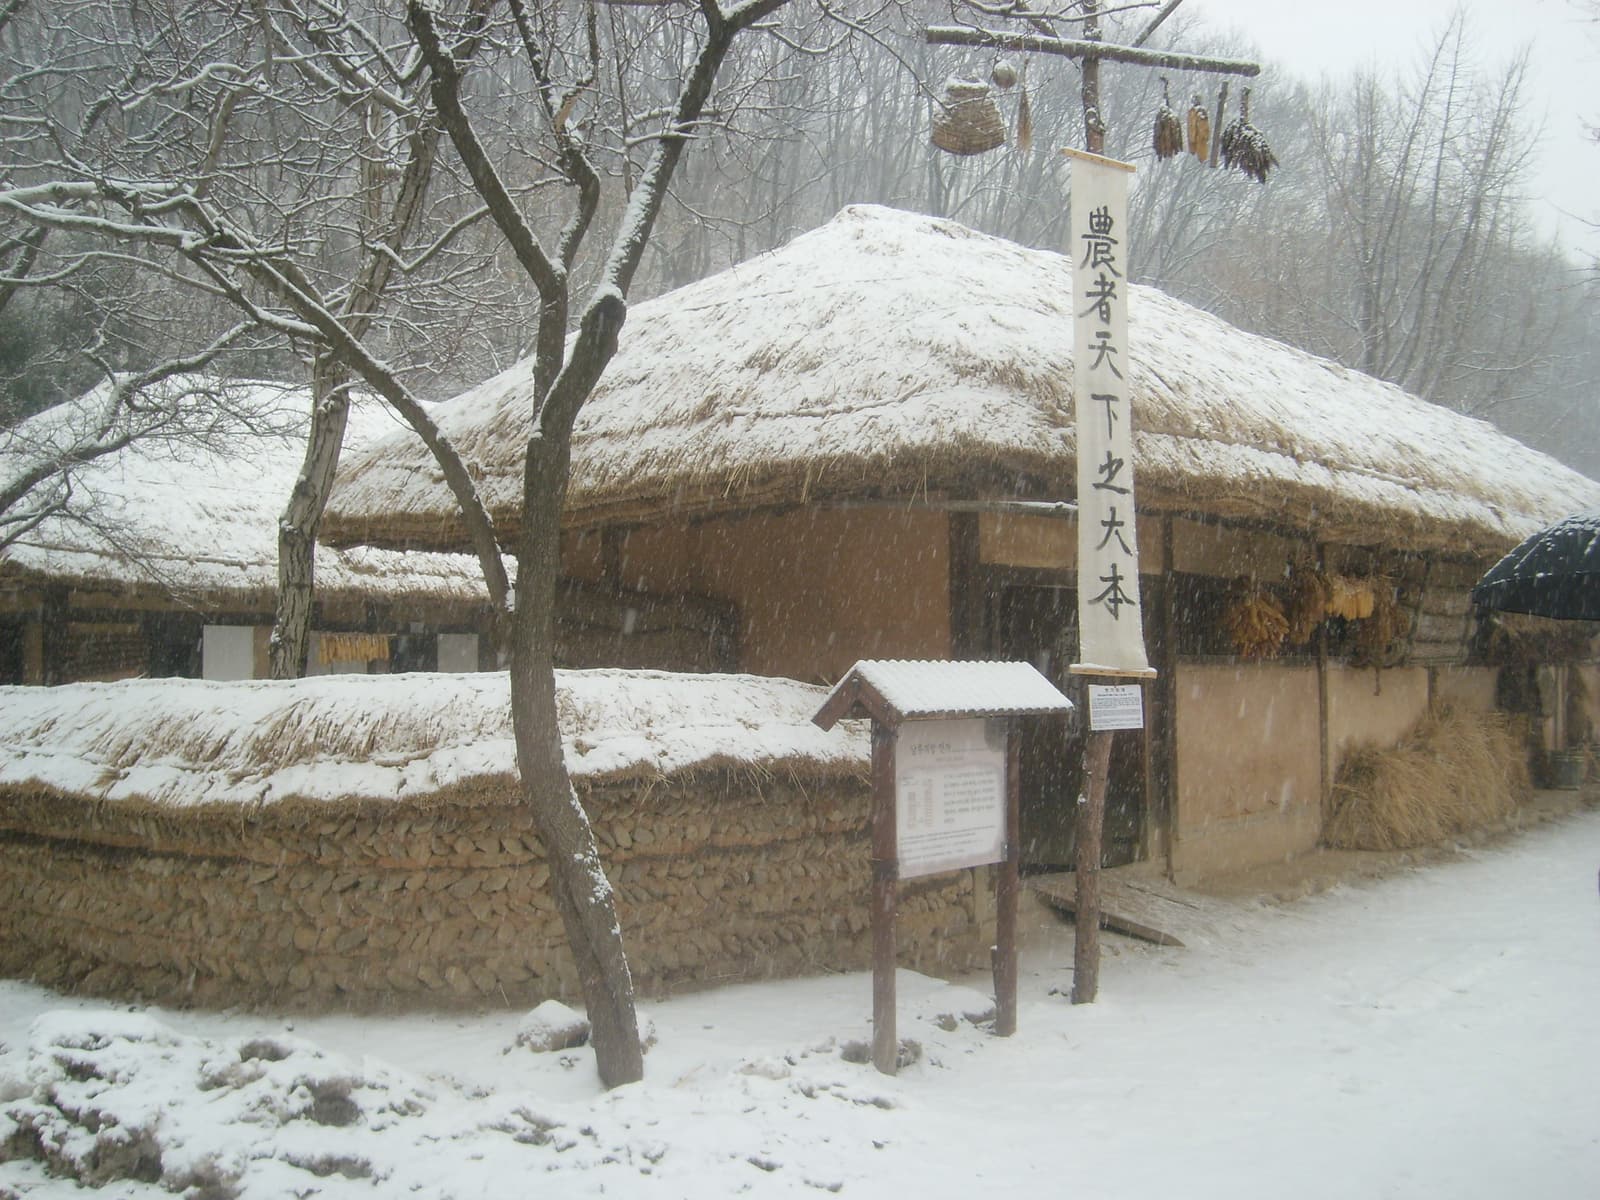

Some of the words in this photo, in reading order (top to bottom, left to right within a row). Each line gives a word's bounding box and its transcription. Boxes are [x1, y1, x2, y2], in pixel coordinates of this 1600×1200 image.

[1078, 205, 1136, 621] 農者天下之大本
